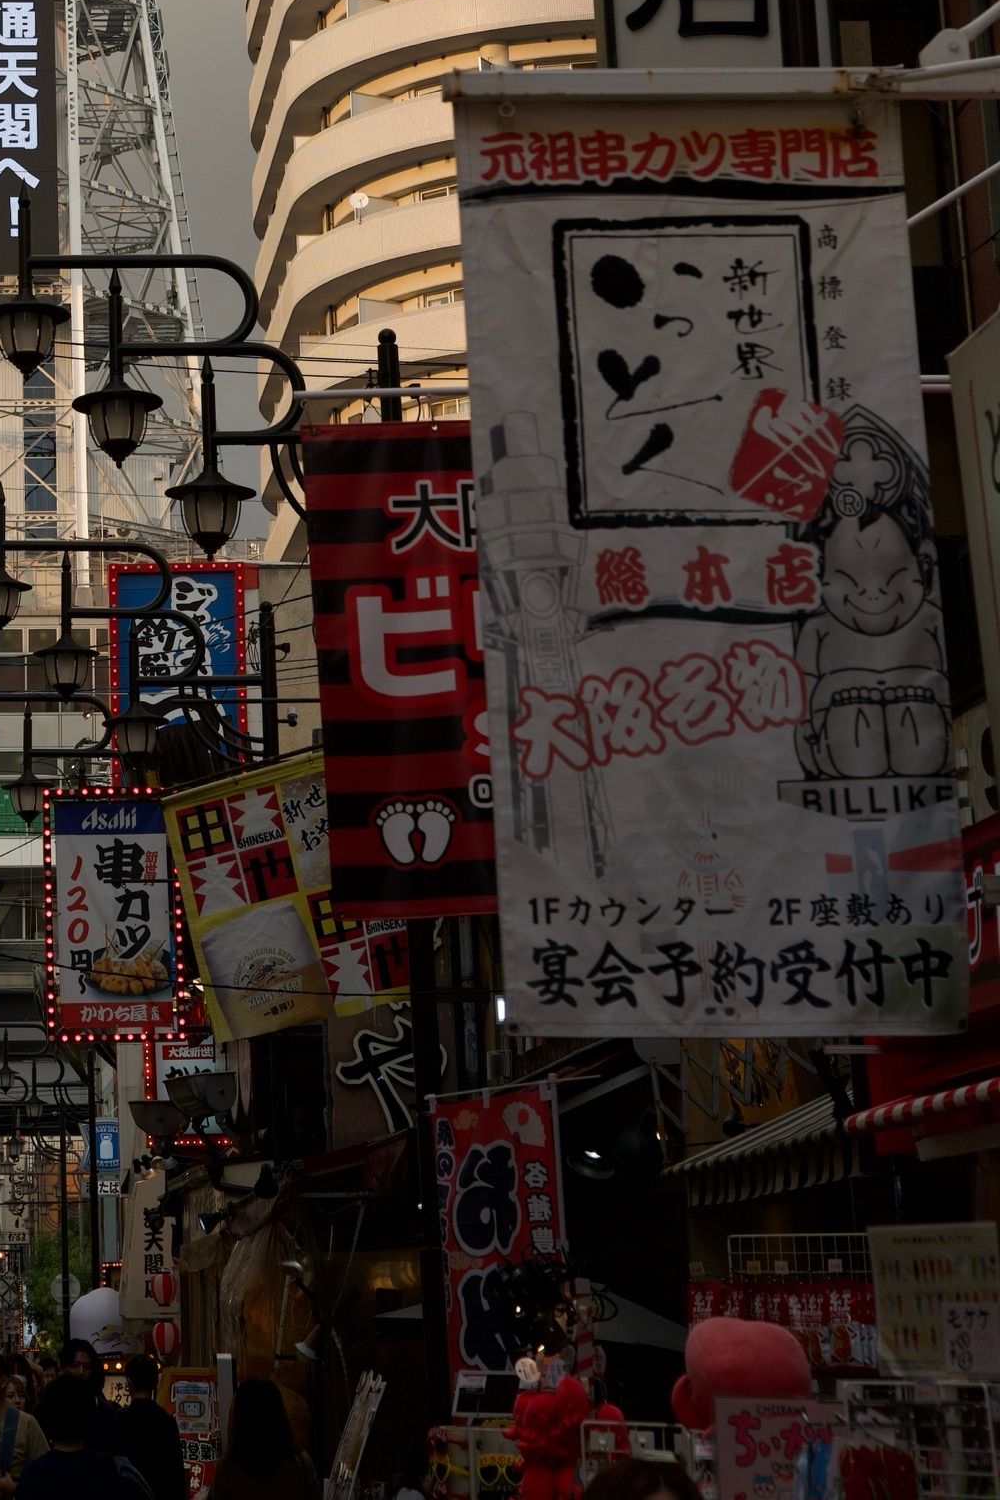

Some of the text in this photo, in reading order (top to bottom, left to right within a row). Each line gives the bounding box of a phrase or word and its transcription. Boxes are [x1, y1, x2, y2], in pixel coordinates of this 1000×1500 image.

[479, 129, 878, 183] 元祖串カツ専門店
[724, 257, 785, 380] 新世界
[817, 224, 853, 401] 商標登録
[595, 546, 822, 609] 総本店
[512, 639, 808, 779] 大阪名物
[81, 806, 137, 830] Asahi
[282, 784, 327, 824] 新世
[301, 817, 329, 852] おや
[93, 838, 151, 959] 串カツ
[527, 895, 735, 929] 1Fカウンター
[366, 915, 407, 935] SHINSEKA
[526, 939, 954, 1010] 宴会予約受付中
[79, 1004, 148, 1023] かわち屋
[95, 1125, 119, 1133] AWSO
